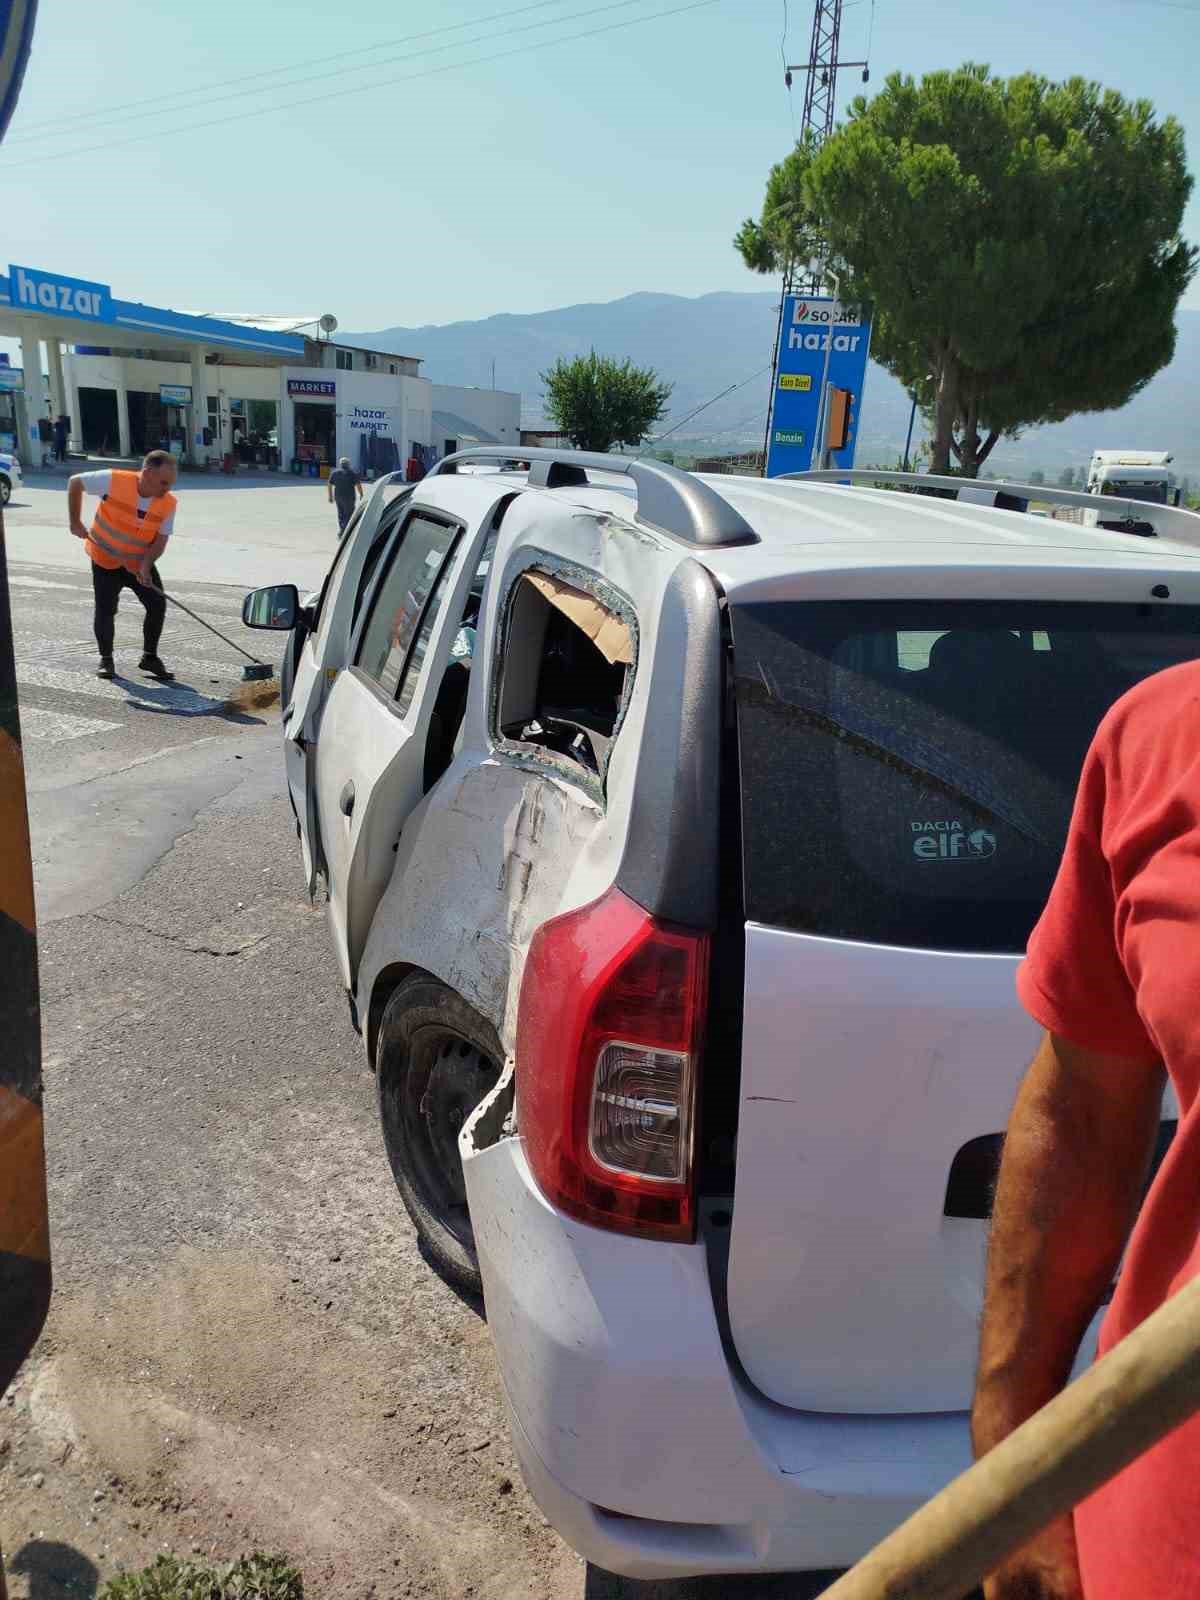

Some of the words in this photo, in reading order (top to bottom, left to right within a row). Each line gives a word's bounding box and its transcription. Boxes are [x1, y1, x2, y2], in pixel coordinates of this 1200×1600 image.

[16, 268, 102, 316] hazar
[788, 328, 860, 352] hazar
[289, 382, 332, 393] MARKET
[354, 407, 386, 419] hazar
[350, 421, 389, 431] MARKET
[775, 431, 802, 443] Benzin
[911, 821, 962, 832] DACIA
[913, 832, 967, 858] elf
